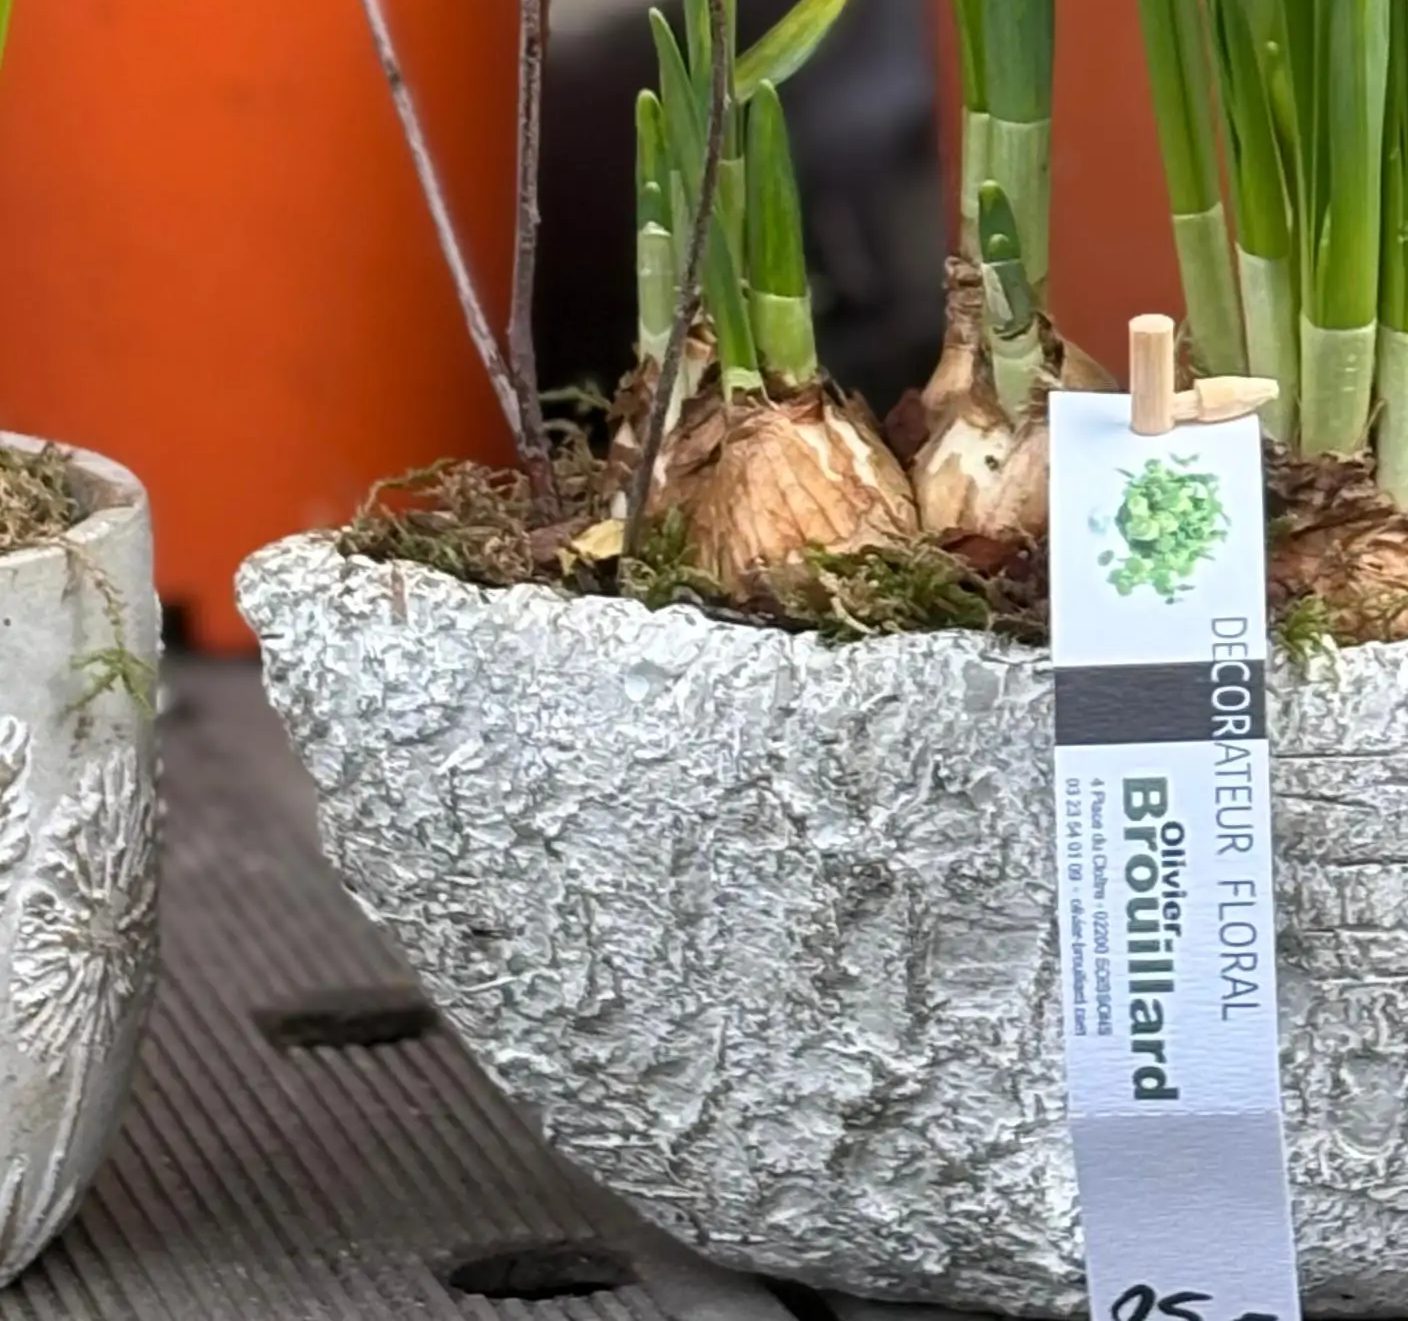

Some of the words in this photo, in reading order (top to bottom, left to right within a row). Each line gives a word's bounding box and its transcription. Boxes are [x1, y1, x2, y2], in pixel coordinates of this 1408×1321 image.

[1211, 617, 1254, 855] DECORATEUR
[1065, 777, 1081, 795] 03
[1066, 799, 1082, 817] 23
[1067, 841, 1083, 859] 01
[1092, 832, 1108, 852] du
[1160, 821, 1188, 937] Olivier
[1094, 911, 1110, 955] 02200
[1123, 777, 1180, 1100] Brouillard
[1217, 879, 1261, 1022] FLORAL
